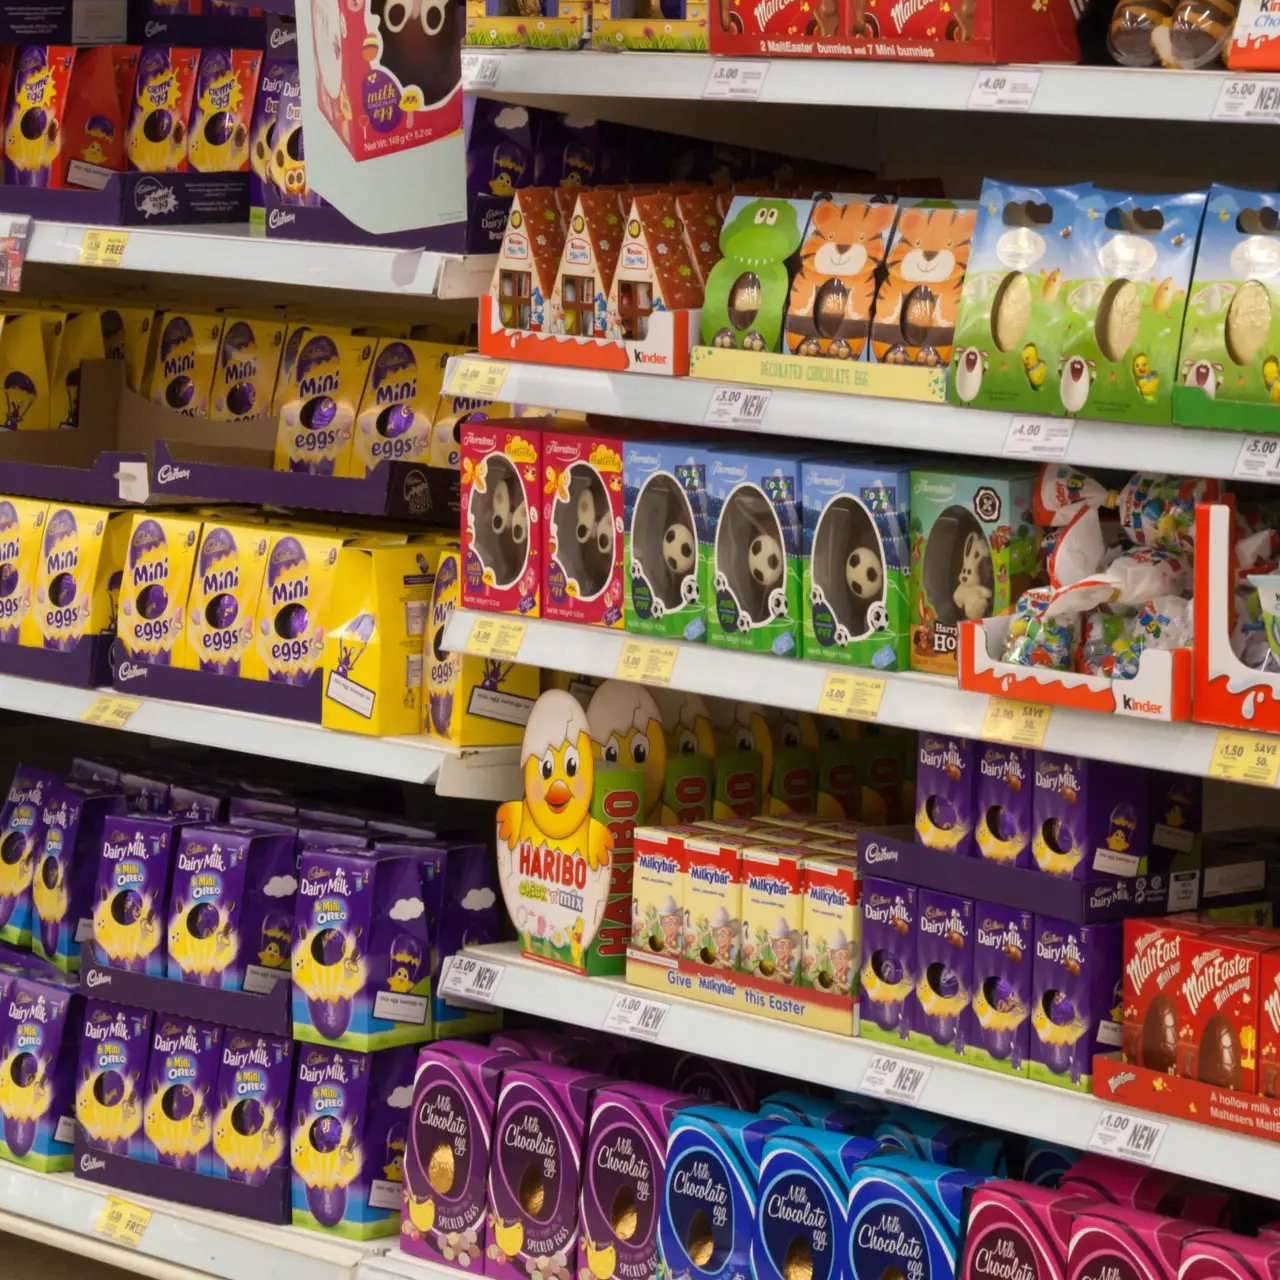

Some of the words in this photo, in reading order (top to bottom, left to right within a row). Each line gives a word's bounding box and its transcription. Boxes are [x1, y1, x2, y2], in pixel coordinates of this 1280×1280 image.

[367, 86, 396, 103] milk
[271, 579, 309, 606] Mini
[271, 638, 311, 662] eggs
[519, 844, 587, 890] HARIBO
[638, 853, 677, 875] Milkybar
[978, 930, 1001, 947] Dairy
[667, 970, 692, 988] Give
[699, 976, 737, 996] Milkybar
[745, 989, 764, 1005] this
[768, 994, 806, 1016] Easter
[1182, 953, 1253, 1015] MaltEaster
[1210, 1092, 1217, 1102] A
[1220, 1094, 1247, 1109] hollow
[1251, 1099, 1270, 1113] milk
[419, 1101, 467, 1136] Chocolate
[1210, 1108, 1252, 1128] Maltesers
[1128, 1126, 1158, 1152] NEW
